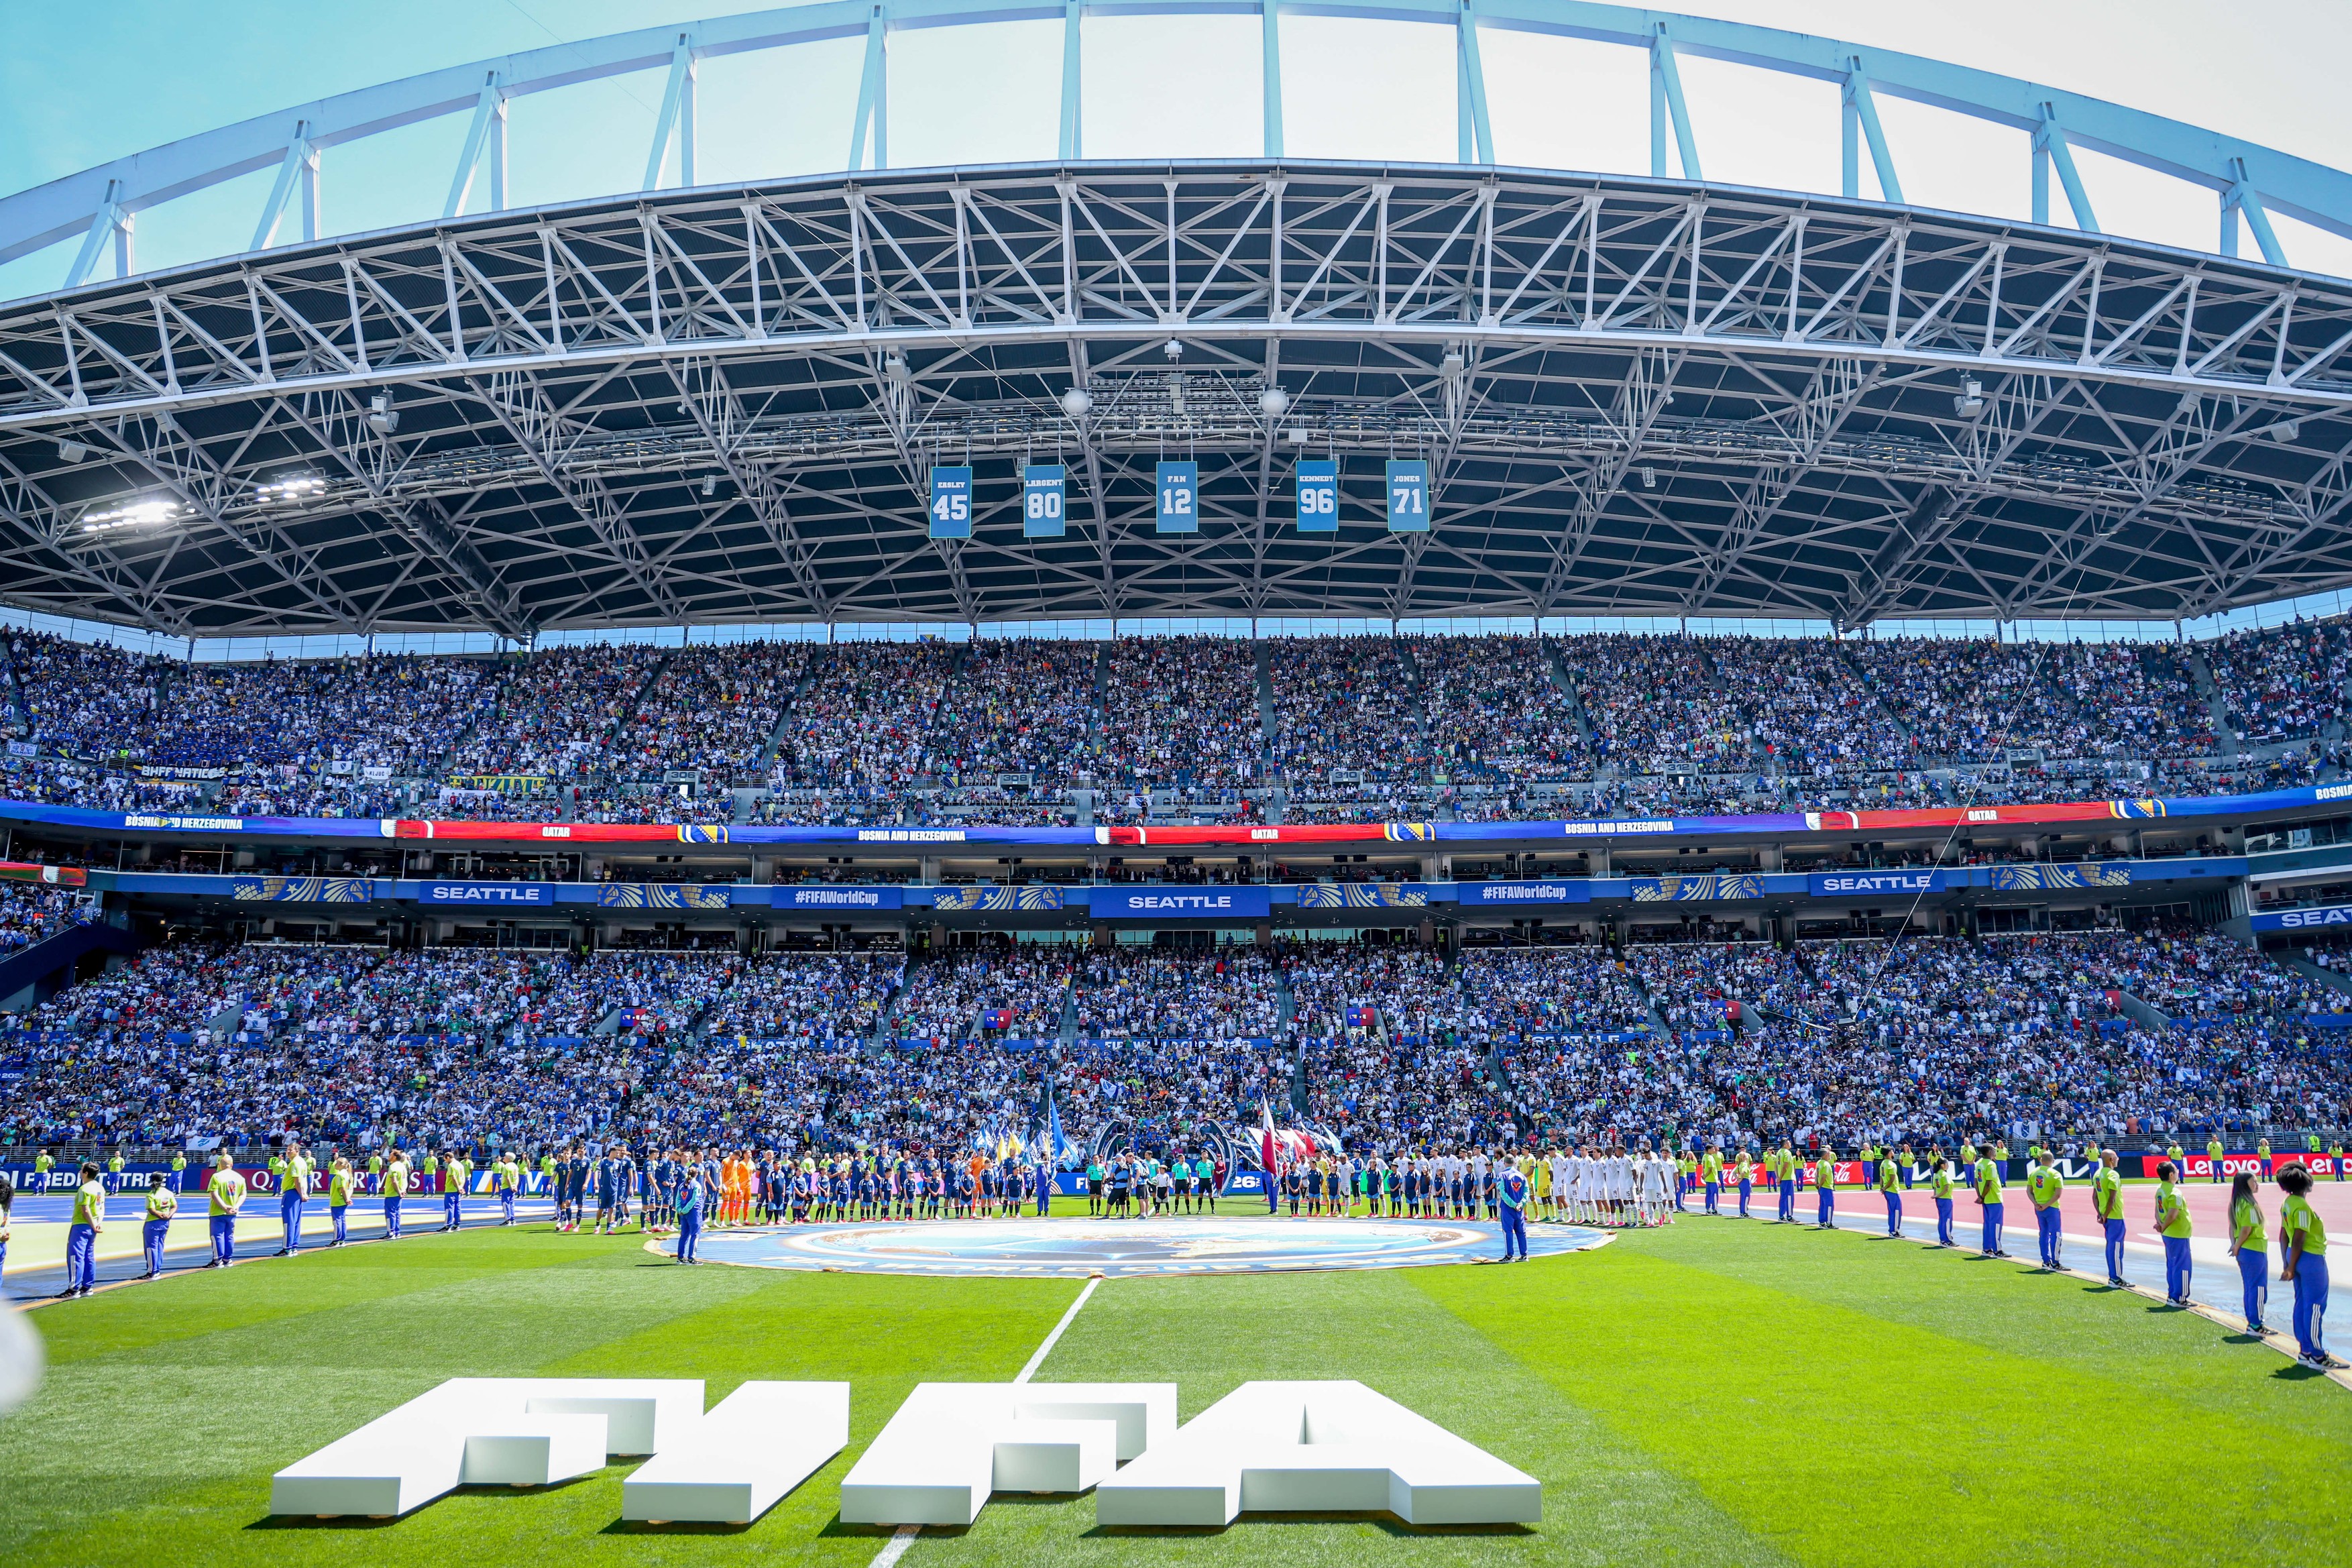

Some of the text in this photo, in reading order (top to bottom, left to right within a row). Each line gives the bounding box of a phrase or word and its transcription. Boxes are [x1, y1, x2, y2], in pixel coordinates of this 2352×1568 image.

[1025, 479, 1063, 487] LARGENT
[932, 495, 968, 520] 45
[1027, 492, 1060, 518] 80
[1163, 489, 1191, 514] 12
[1300, 488, 1334, 513] 96
[1393, 488, 1422, 513] 71
[1968, 810, 1997, 821] QATAR
[182, 818, 242, 830] HERZEGOVINA
[1565, 821, 1674, 834] BOSNIA AND HERZEGOVINA
[542, 826, 570, 838] QATAR
[858, 831, 966, 841] BOSNIA AND HERZEGOVINA
[1251, 829, 1278, 840] QATAR
[1824, 875, 1931, 891] SEATTLE
[433, 887, 539, 900] SEATTLE
[795, 891, 879, 906] #FIFAWorldCup
[1483, 885, 1566, 900] #FIFAWorldCup
[1128, 896, 1231, 908] SEATTLE
[270, 1377, 1542, 1526] FIFA
